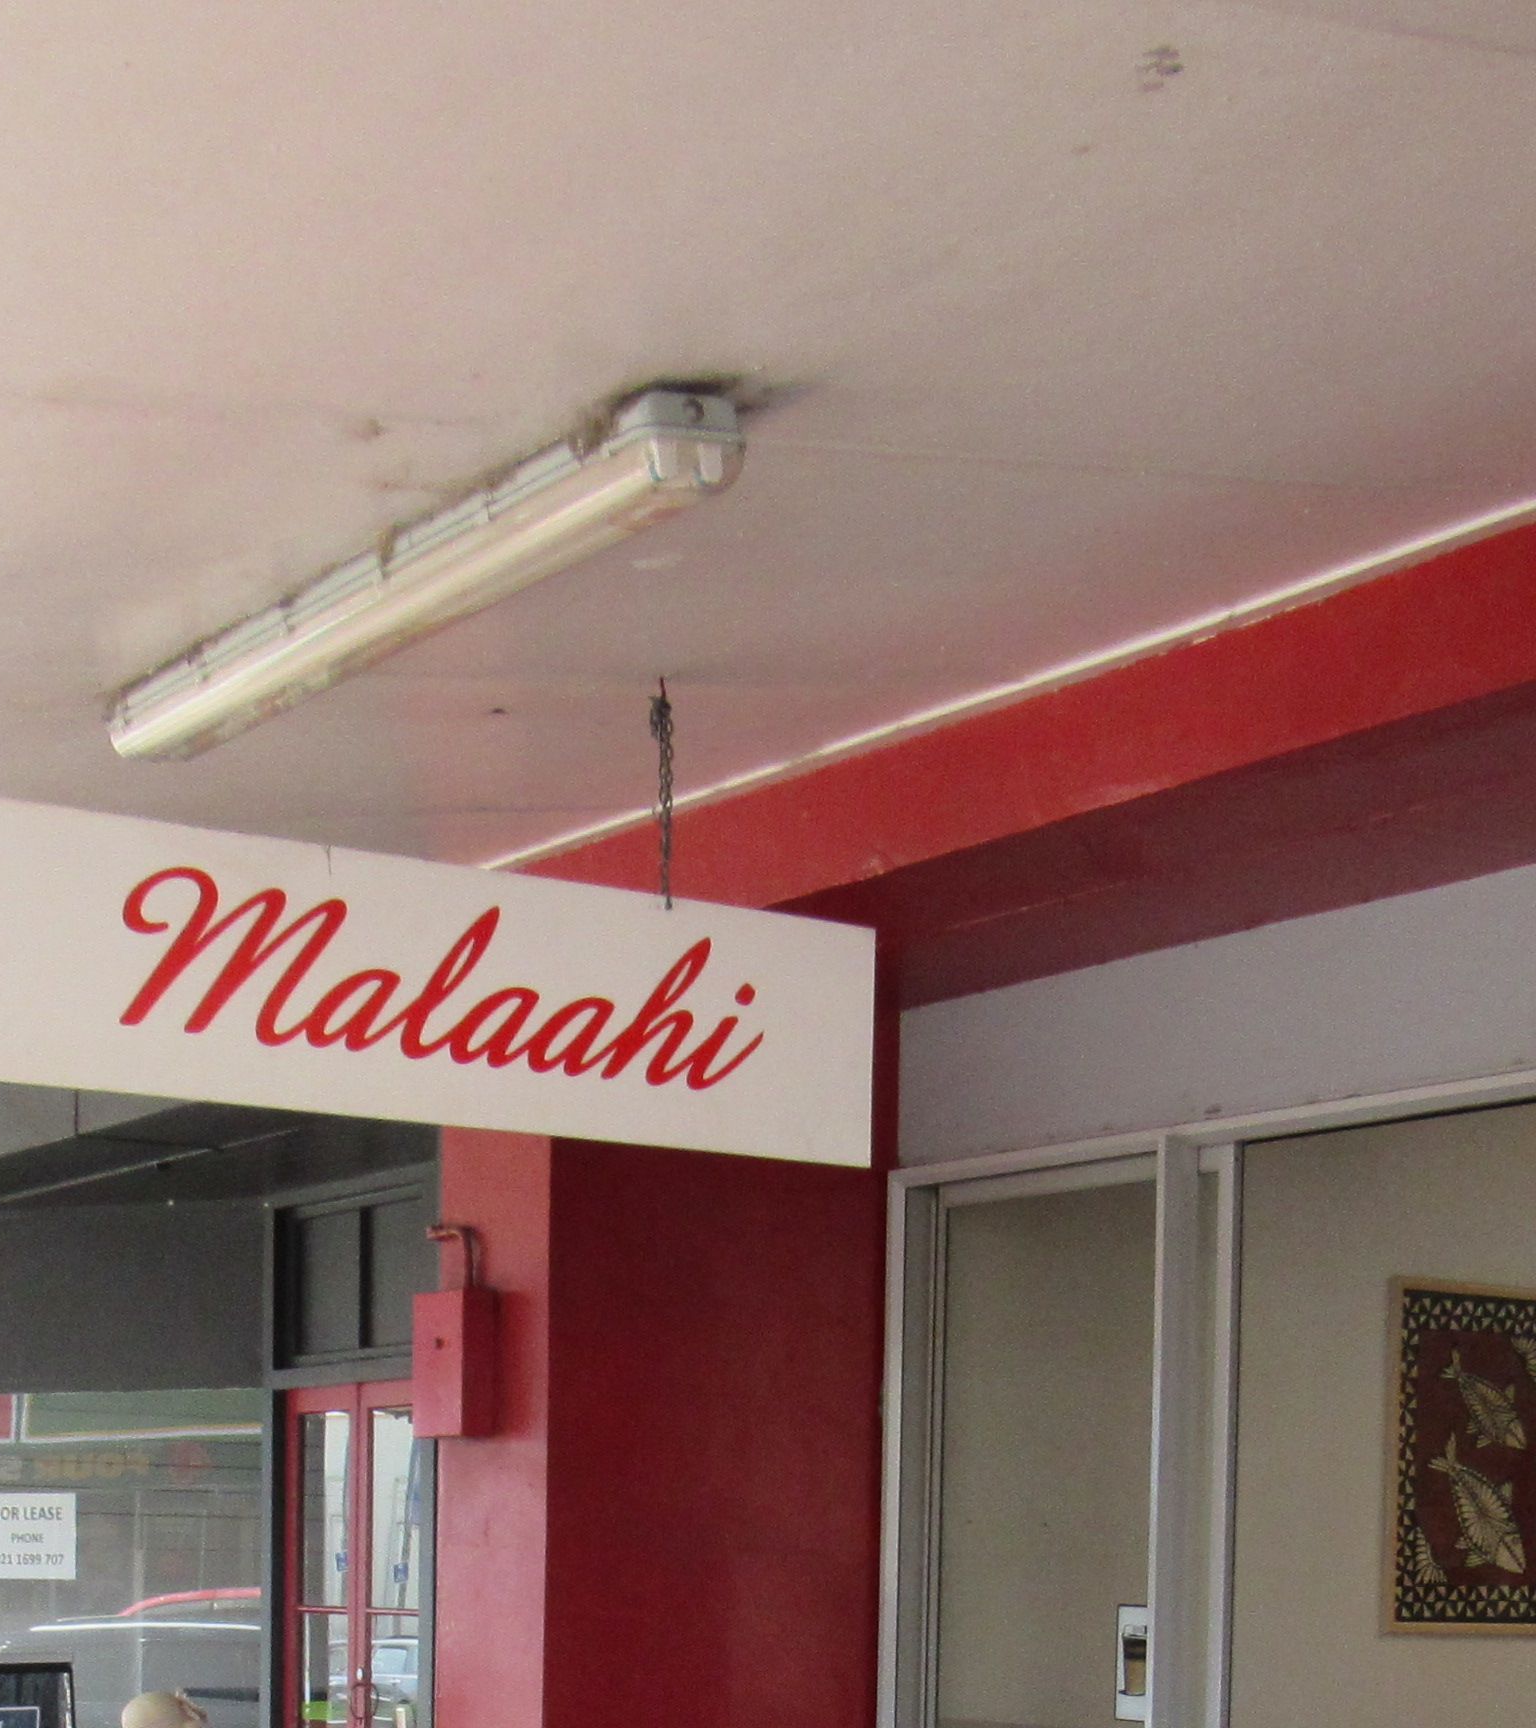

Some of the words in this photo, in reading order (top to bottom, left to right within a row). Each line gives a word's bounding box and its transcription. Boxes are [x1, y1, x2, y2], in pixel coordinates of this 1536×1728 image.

[120, 868, 764, 1090] Malaahi
[23, 1506, 63, 1521] LEASE
[11, 1532, 44, 1544] PHONE
[45, 1554, 64, 1566] 707
